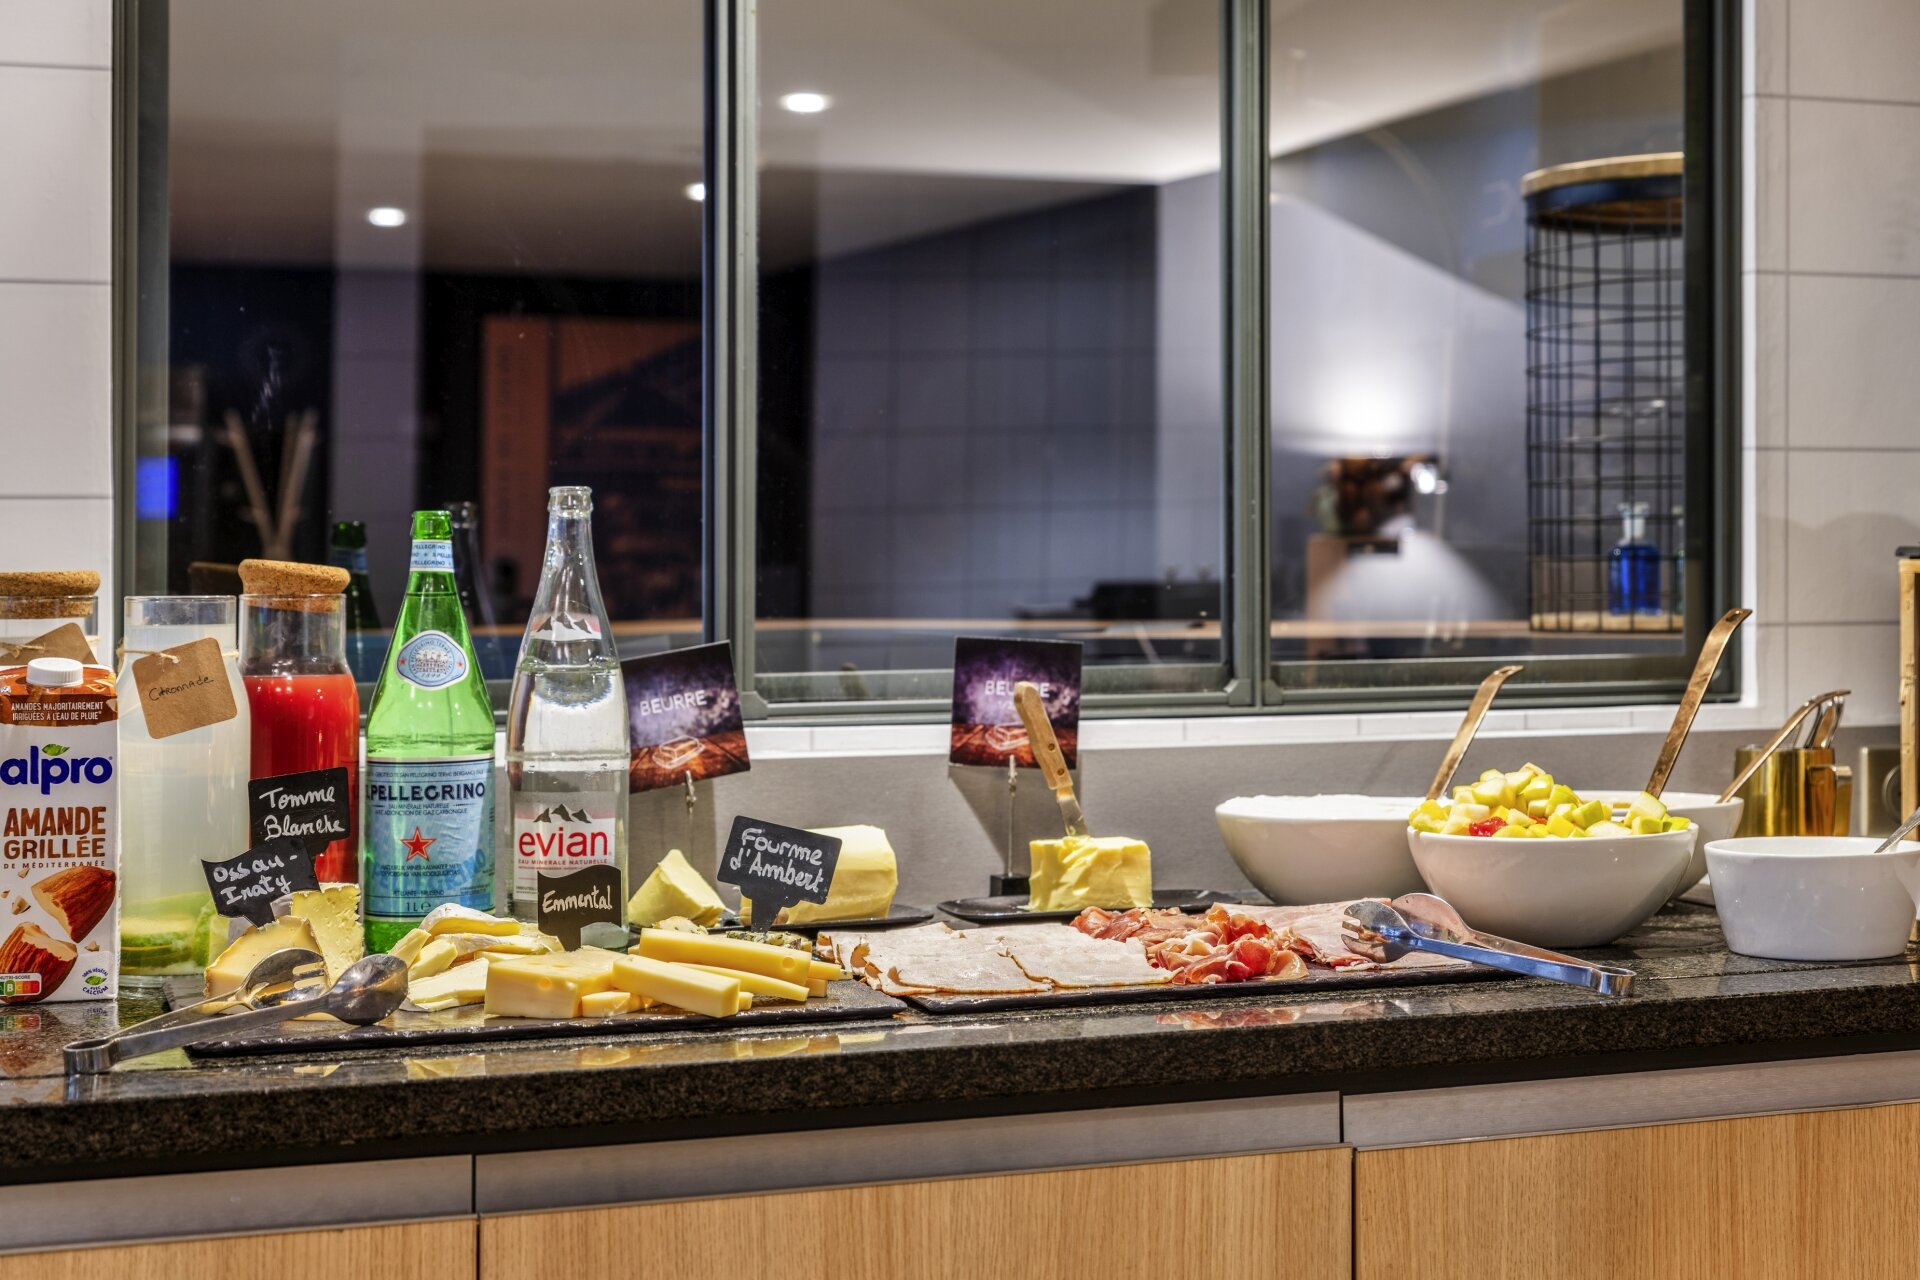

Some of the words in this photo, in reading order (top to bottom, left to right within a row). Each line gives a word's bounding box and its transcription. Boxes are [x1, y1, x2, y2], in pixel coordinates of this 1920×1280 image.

[640, 689, 707, 716] BEURRE
[984, 680, 1051, 698] BEUE
[11, 702, 42, 711] AMANDES
[43, 701, 103, 711] MAJORITAIREMENT
[12, 711, 45, 721] IRRIGUÉES
[70, 711, 80, 720] DE
[0, 745, 113, 795] alpro
[258, 786, 335, 809] Tomme
[3, 806, 106, 837] AMANDE
[263, 814, 346, 841] Blanche
[3, 836, 106, 860] GRILLÉE
[518, 826, 608, 857] evian
[741, 827, 823, 866] Fourme
[22, 860, 105, 869] MÉDITERRANÉE
[729, 847, 824, 893] d'Ambert
[542, 884, 613, 914] Emmental
[82, 985, 109, 996] CALCIUM
